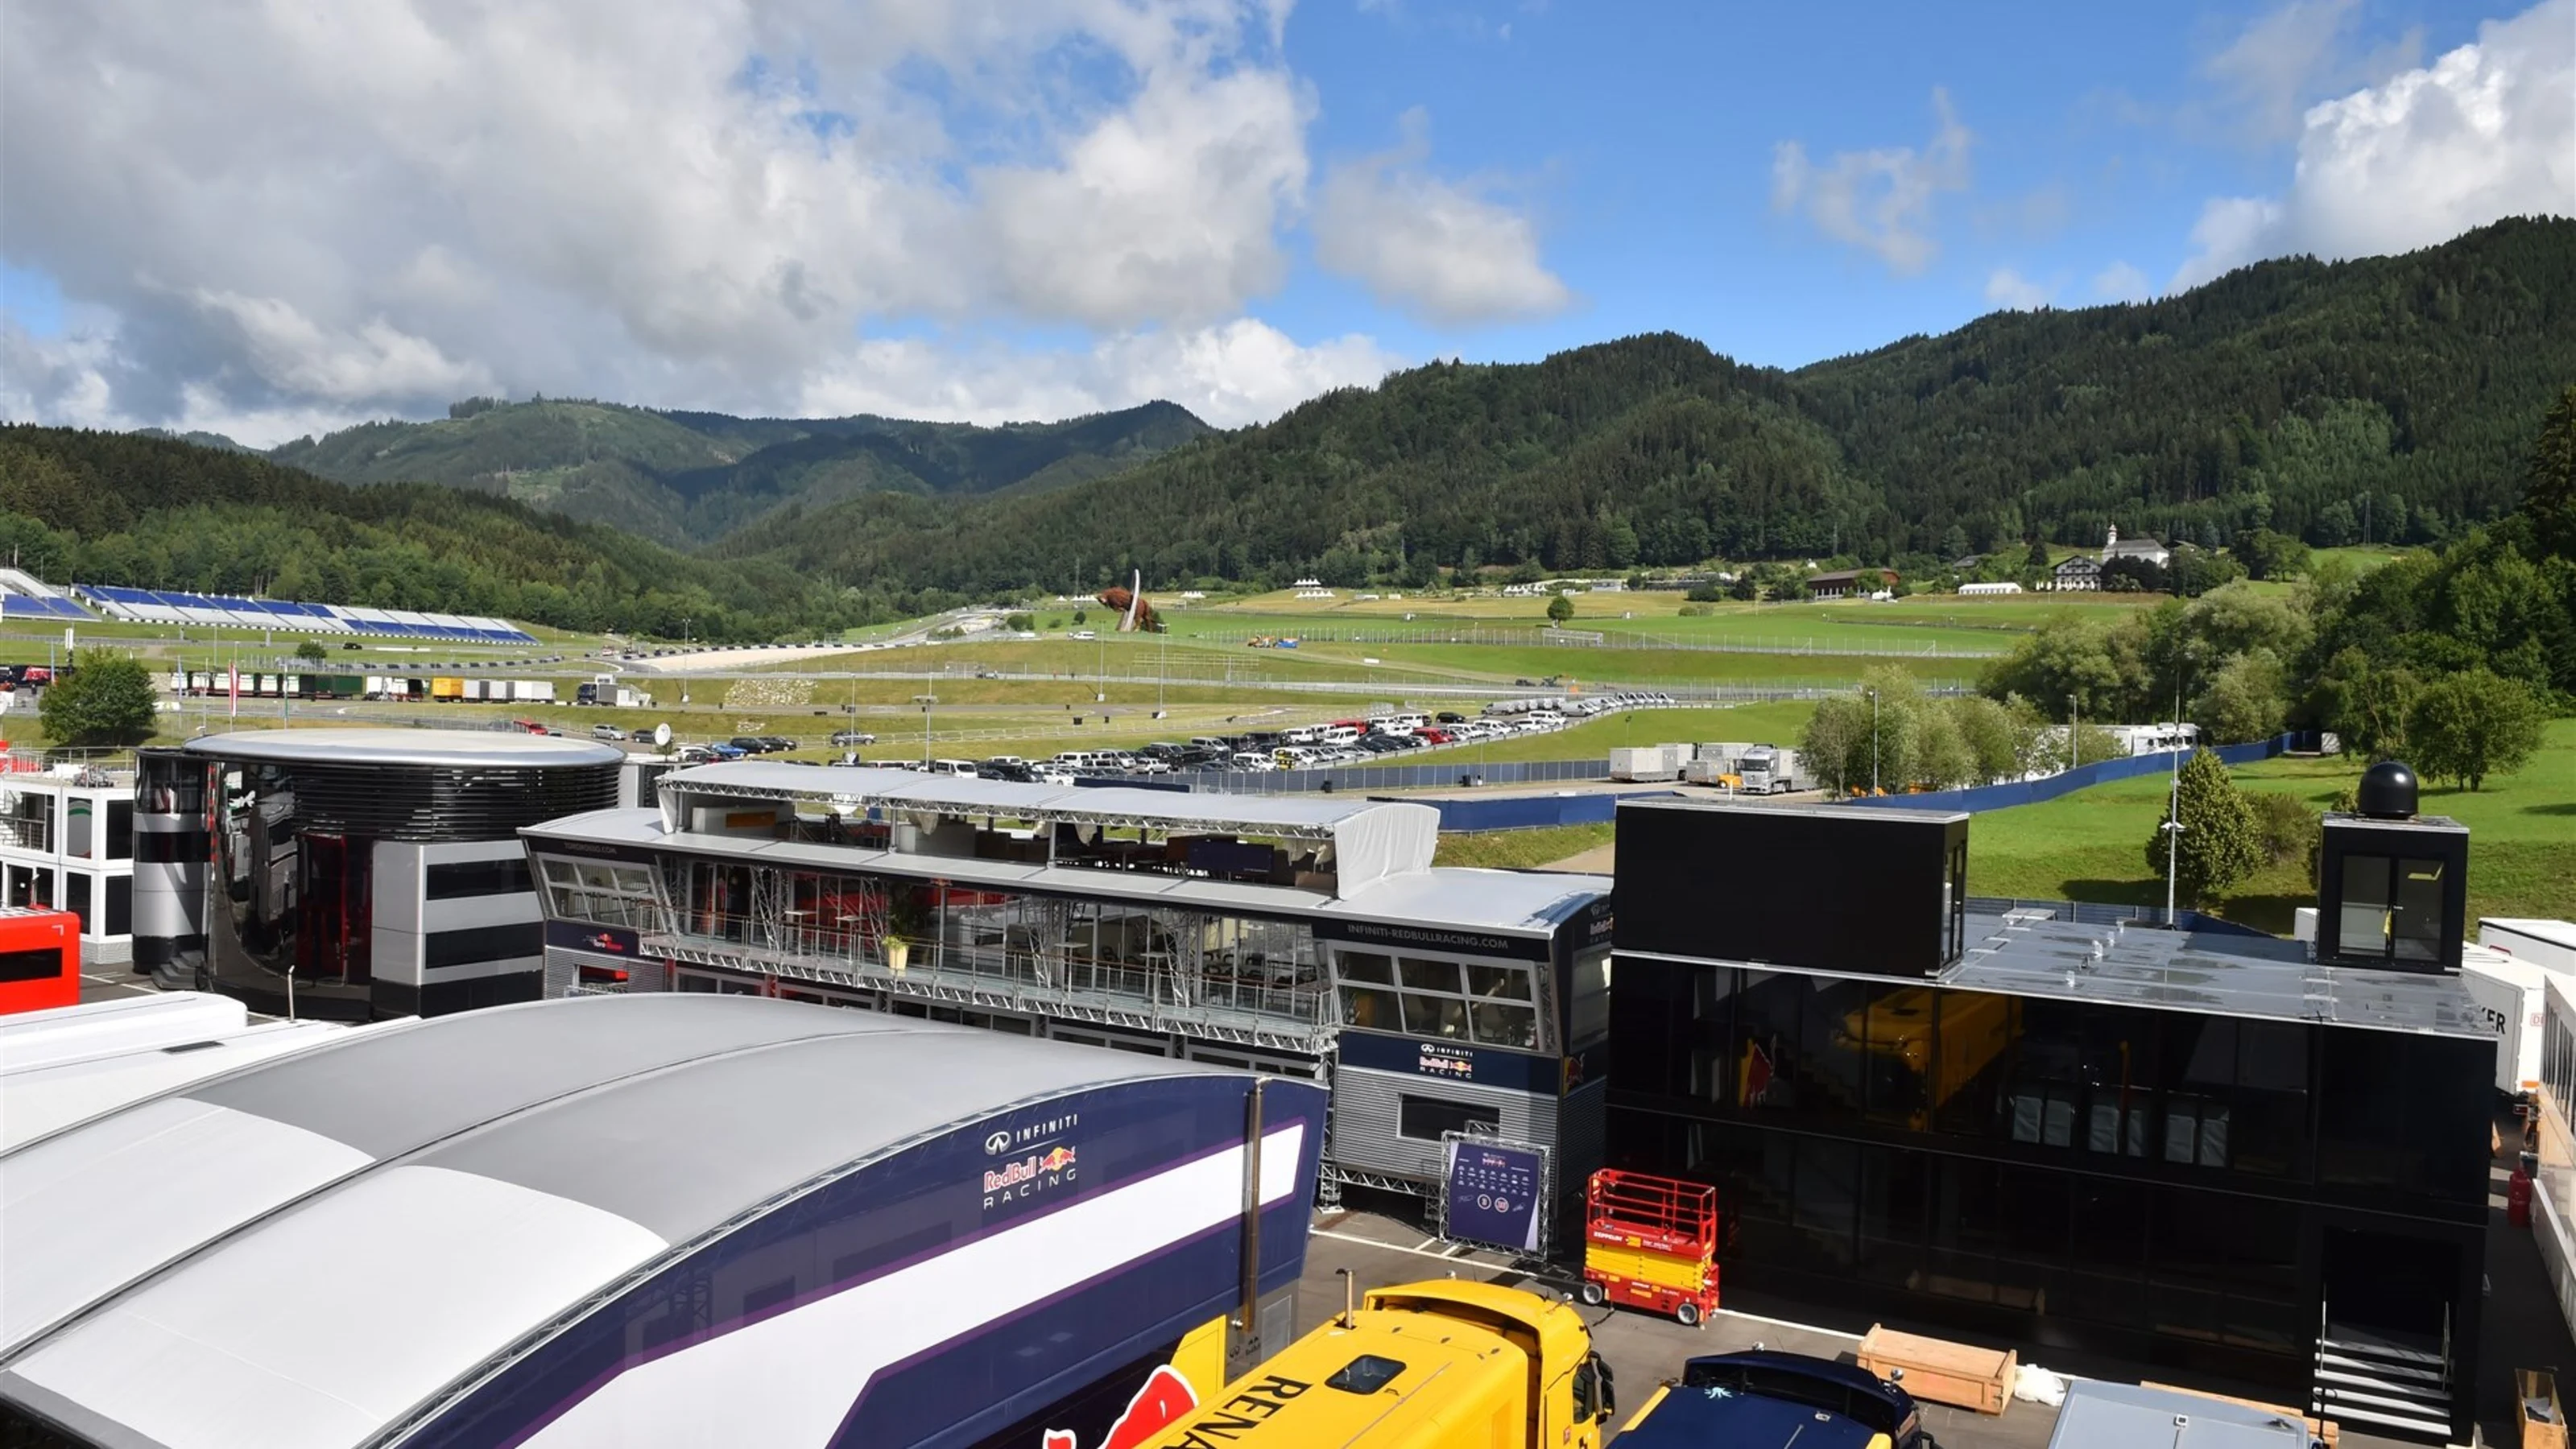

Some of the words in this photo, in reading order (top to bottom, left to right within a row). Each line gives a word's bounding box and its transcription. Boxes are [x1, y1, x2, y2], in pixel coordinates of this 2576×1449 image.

[1347, 924, 1508, 949] INFINITI-REDBULLRACING.COM
[1437, 1047, 1473, 1058] INFINITI
[1420, 1066, 1472, 1079] RACING
[1016, 1113, 1077, 1143] INFINITI
[984, 1168, 1076, 1210] RACING
